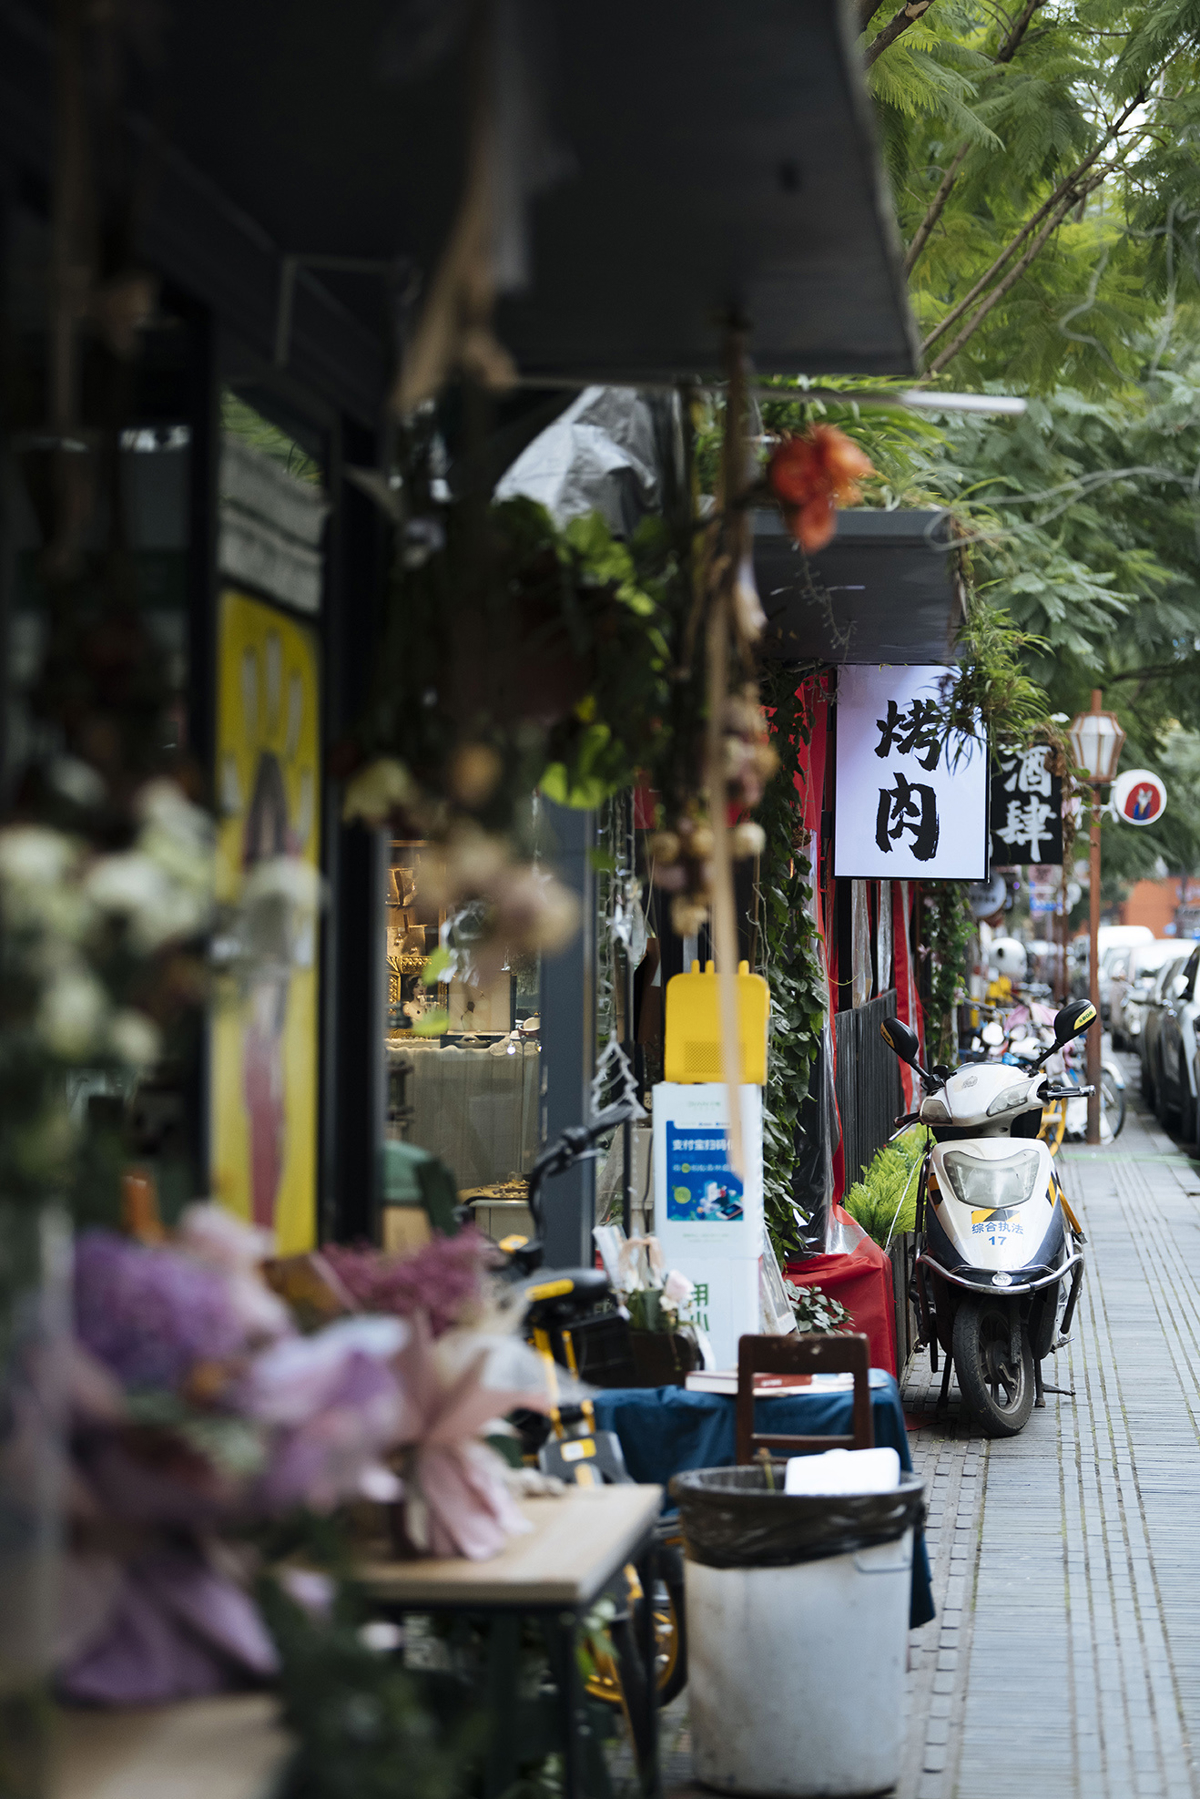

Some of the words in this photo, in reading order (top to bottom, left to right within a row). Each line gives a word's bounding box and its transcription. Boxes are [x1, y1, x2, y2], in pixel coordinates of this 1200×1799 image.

[874, 698, 941, 862] 烤肉
[997, 745, 1058, 864] 酒肆
[971, 1221, 1024, 1235] 综合执法
[988, 1235, 1007, 1246] 17
